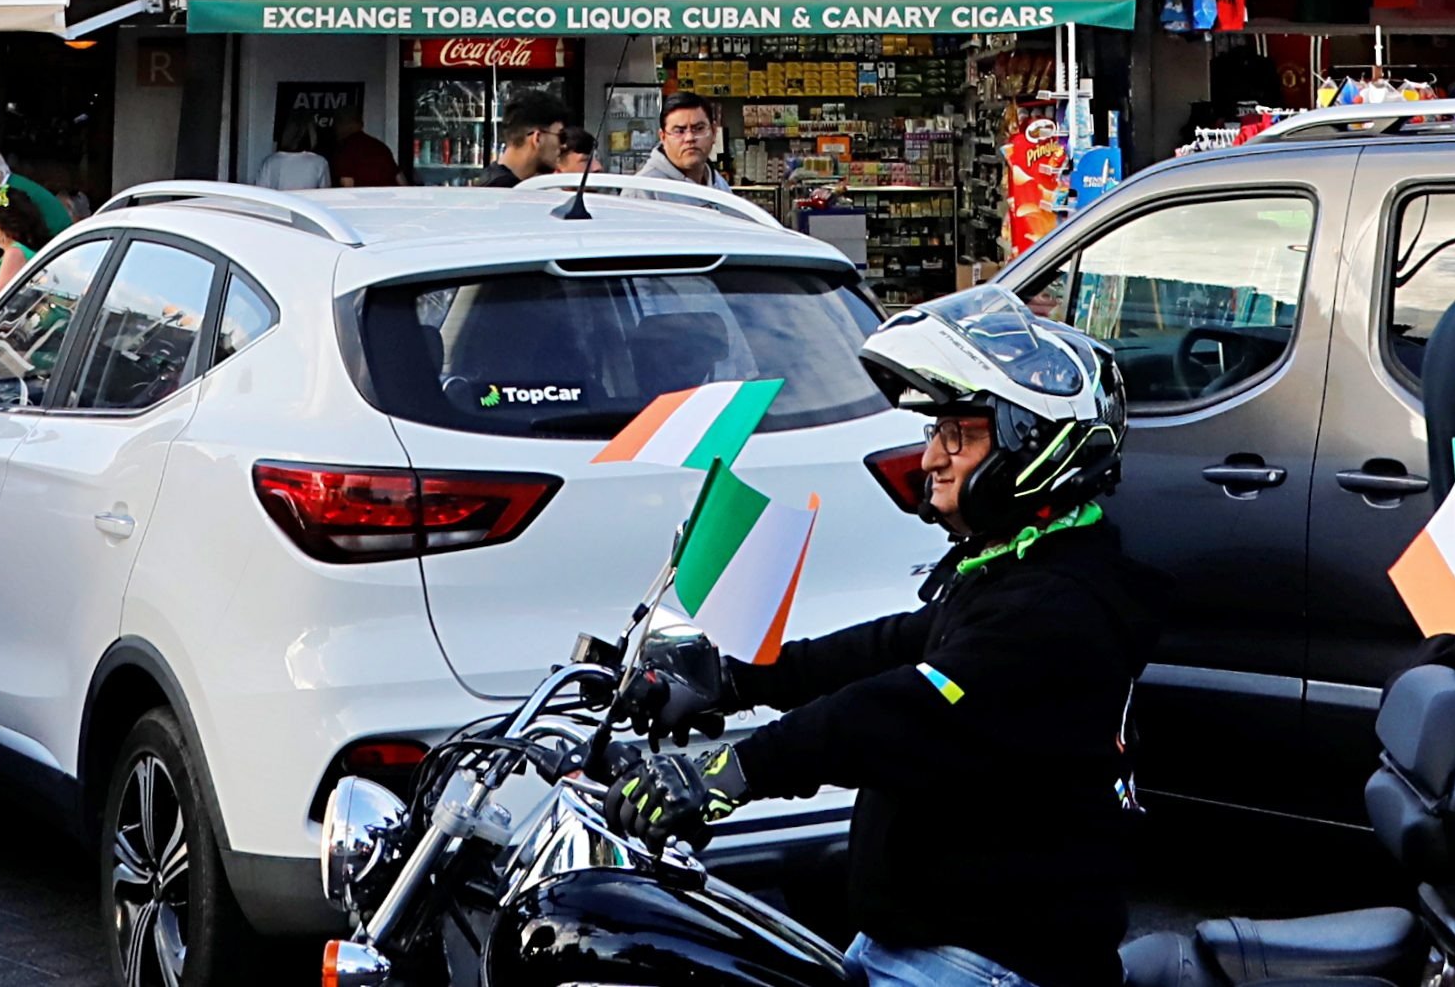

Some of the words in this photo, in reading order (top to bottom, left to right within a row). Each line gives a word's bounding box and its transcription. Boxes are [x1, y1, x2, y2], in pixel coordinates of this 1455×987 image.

[262, 6, 411, 29] EXCHANGE
[421, 7, 557, 29] TOBACCO
[566, 7, 672, 30] LIQUOR
[682, 7, 780, 29] CUBAN
[792, 7, 811, 29] &
[822, 6, 941, 29] CANARY
[950, 5, 1054, 28] CIGARS
[292, 91, 348, 110] ATM
[501, 385, 582, 405] TopCar
